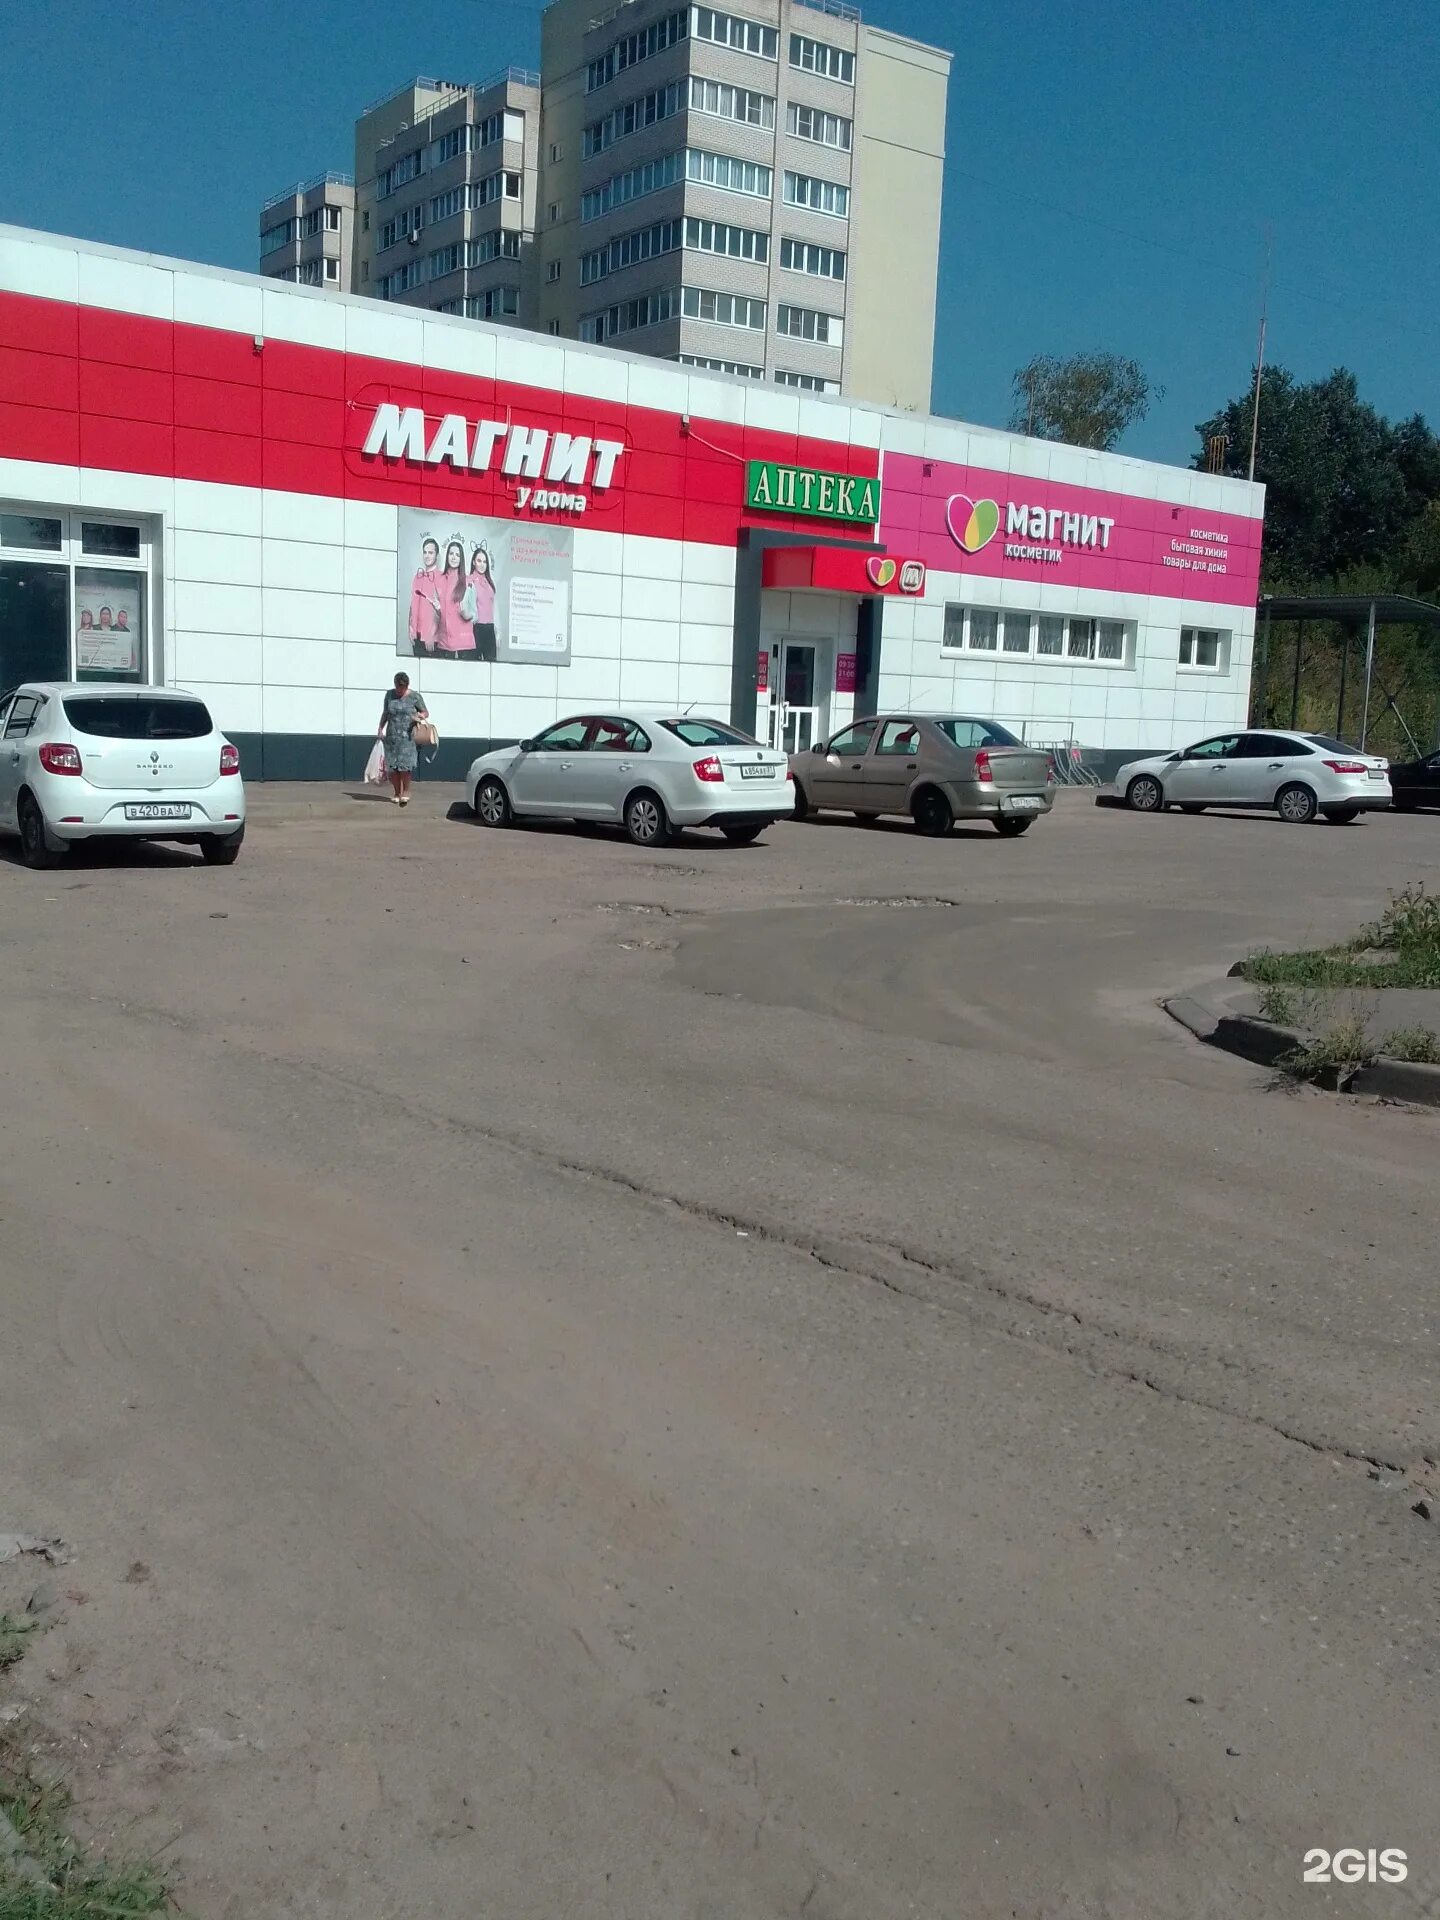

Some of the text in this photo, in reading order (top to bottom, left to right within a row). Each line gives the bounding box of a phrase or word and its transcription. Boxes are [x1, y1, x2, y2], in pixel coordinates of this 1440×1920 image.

[362, 403, 624, 488] МАГНИТ
[516, 487, 586, 512] у дома
[753, 465, 875, 518] АПТЕКА
[1006, 501, 1115, 549] магнит
[1190, 528, 1229, 544] косметика
[1006, 543, 1062, 562] косметик
[1171, 538, 1228, 559] бытовая химия
[1162, 555, 1227, 575] товары для дома
[130, 804, 187, 817] В420ВА 37
